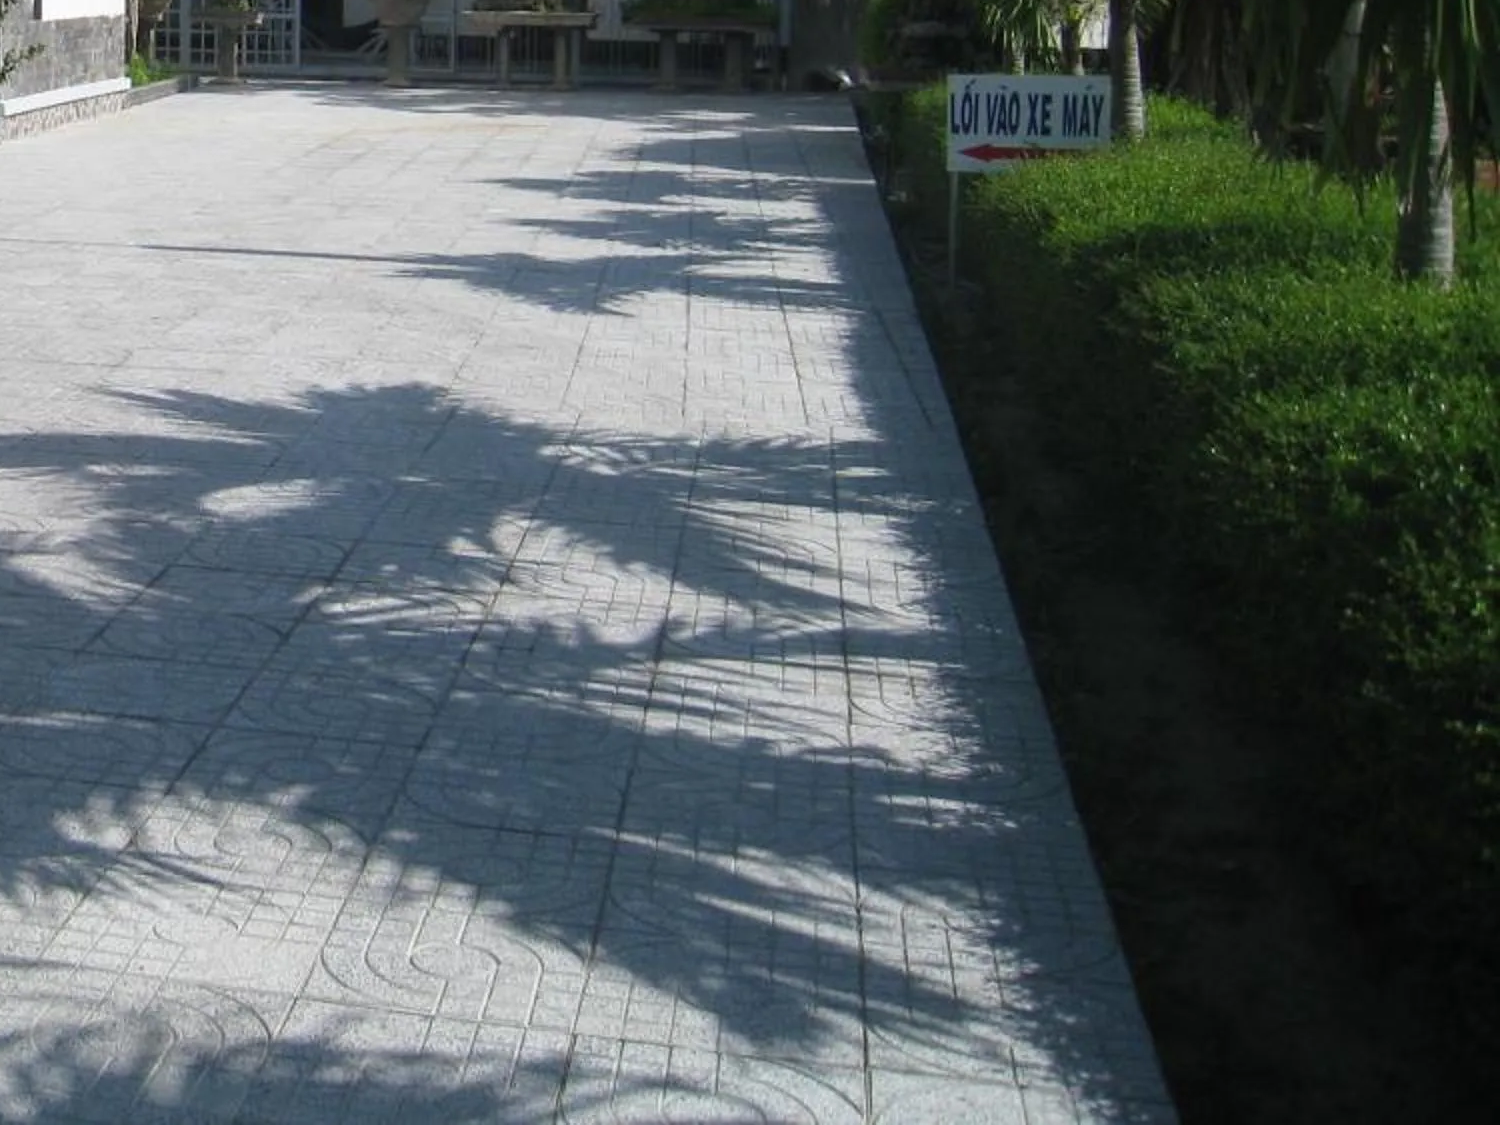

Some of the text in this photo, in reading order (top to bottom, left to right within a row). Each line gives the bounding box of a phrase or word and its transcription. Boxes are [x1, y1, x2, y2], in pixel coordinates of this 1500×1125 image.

[951, 79, 1105, 138] LỐI VÀO XE MÁY
